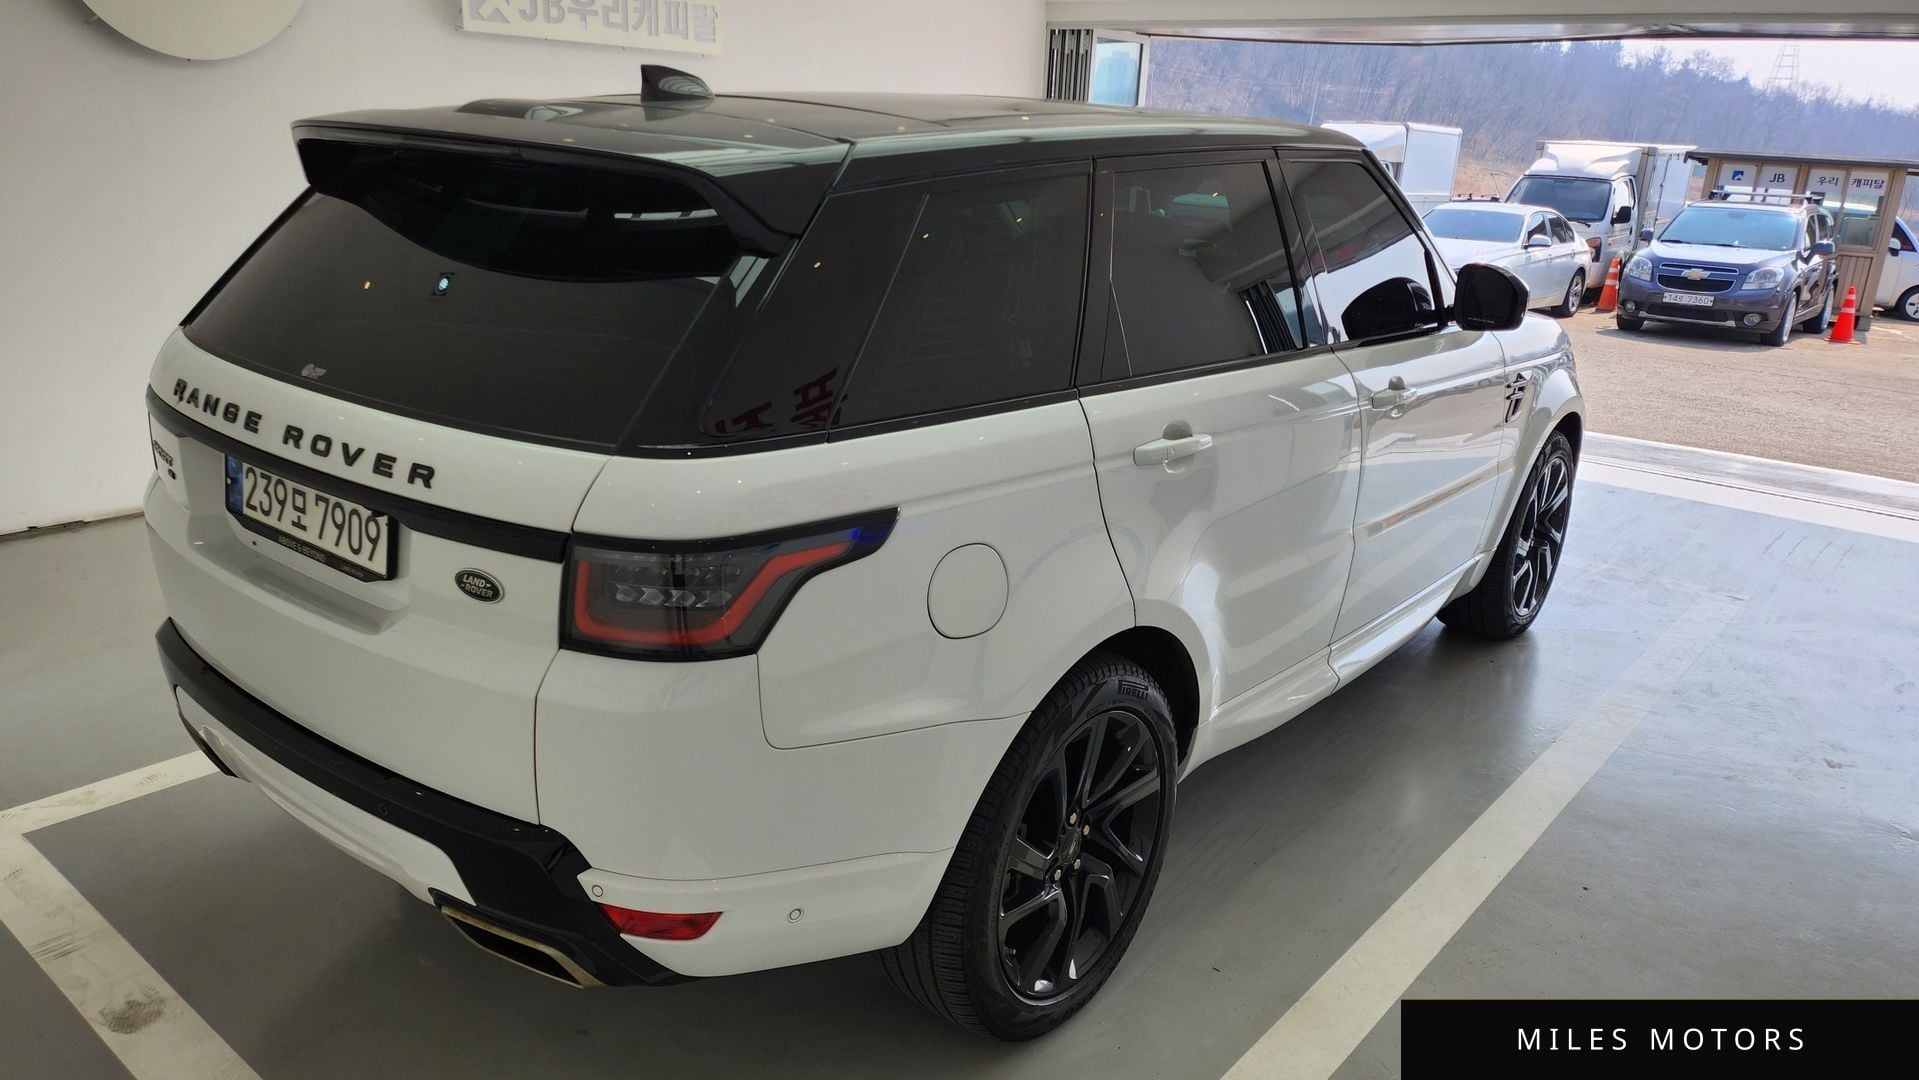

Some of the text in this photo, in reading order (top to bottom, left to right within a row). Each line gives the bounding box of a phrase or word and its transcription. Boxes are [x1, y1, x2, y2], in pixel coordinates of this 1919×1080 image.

[1769, 173, 1785, 183] JB
[1816, 176, 1839, 187] 우리
[173, 378, 436, 489] RANGE ROVER
[245, 466, 381, 562] 239모 7909
[463, 574, 486, 588] LAND
[464, 583, 494, 599] ROVER
[1117, 679, 1149, 700] PIRELLI
